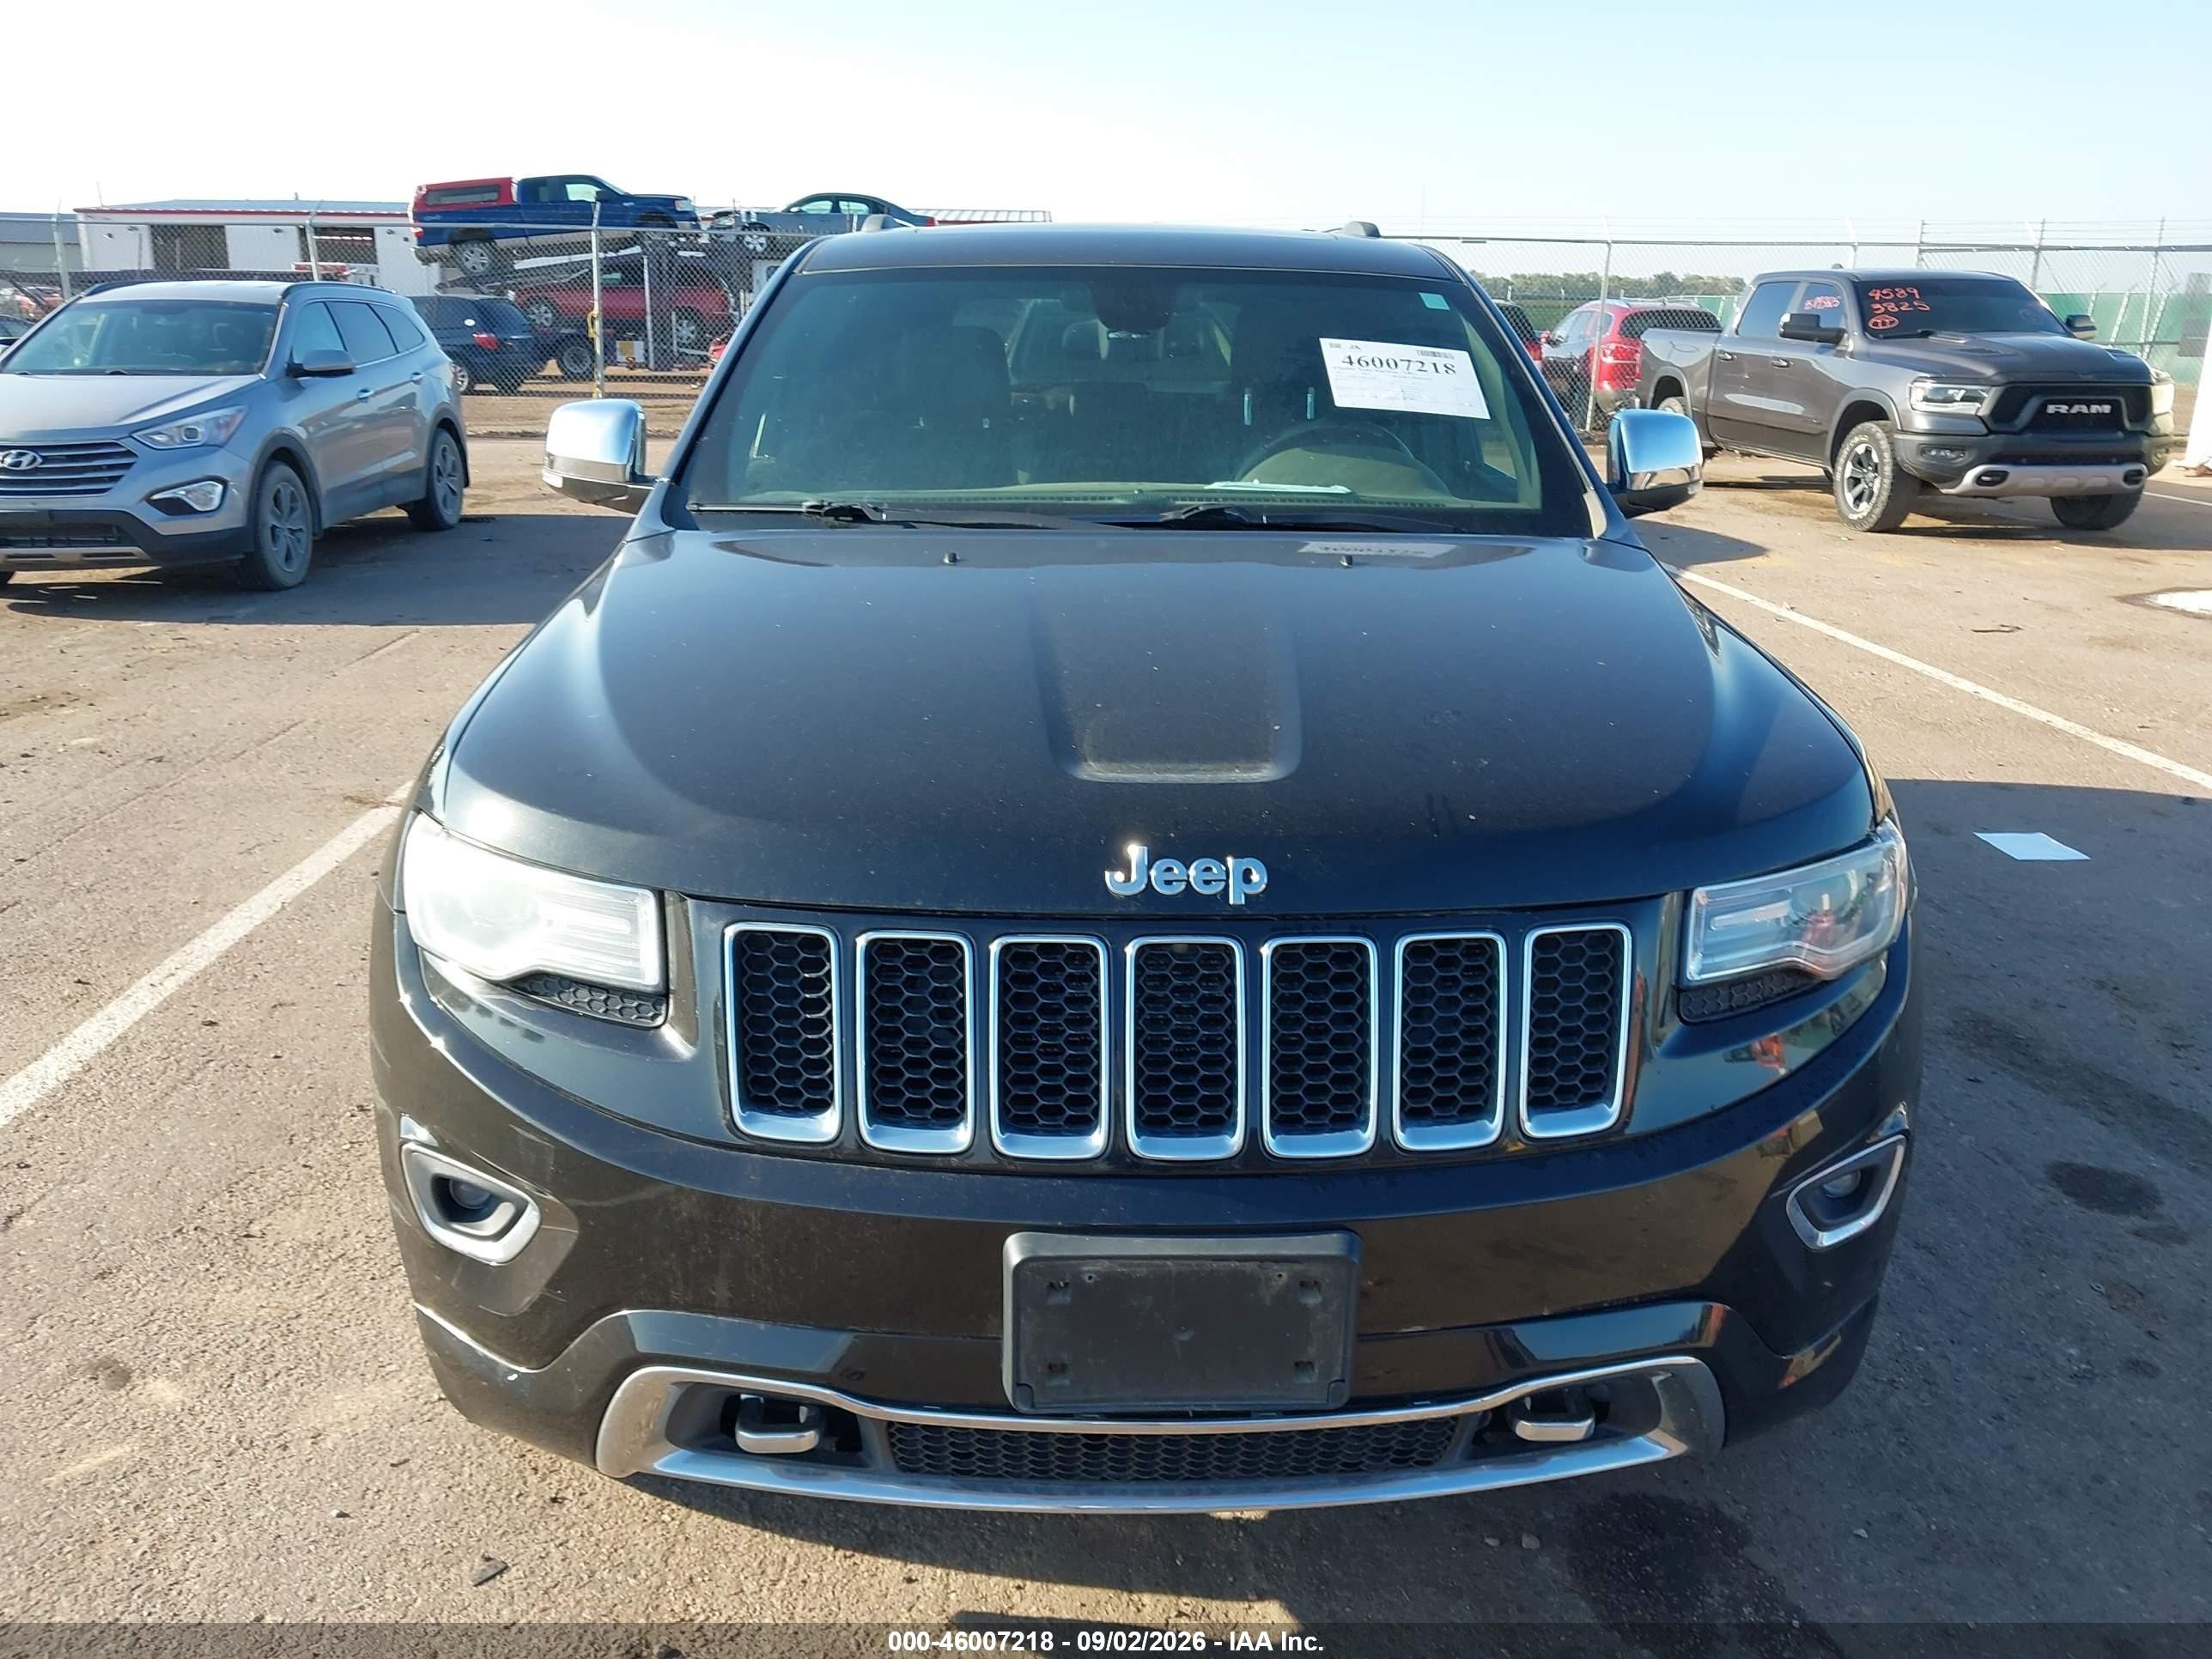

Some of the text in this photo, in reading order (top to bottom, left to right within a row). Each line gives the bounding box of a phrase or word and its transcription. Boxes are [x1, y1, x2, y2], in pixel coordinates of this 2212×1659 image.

[1341, 354, 1456, 376] 46007218
[2046, 404, 2112, 414] RAM
[1105, 844, 1267, 905] Jeep
